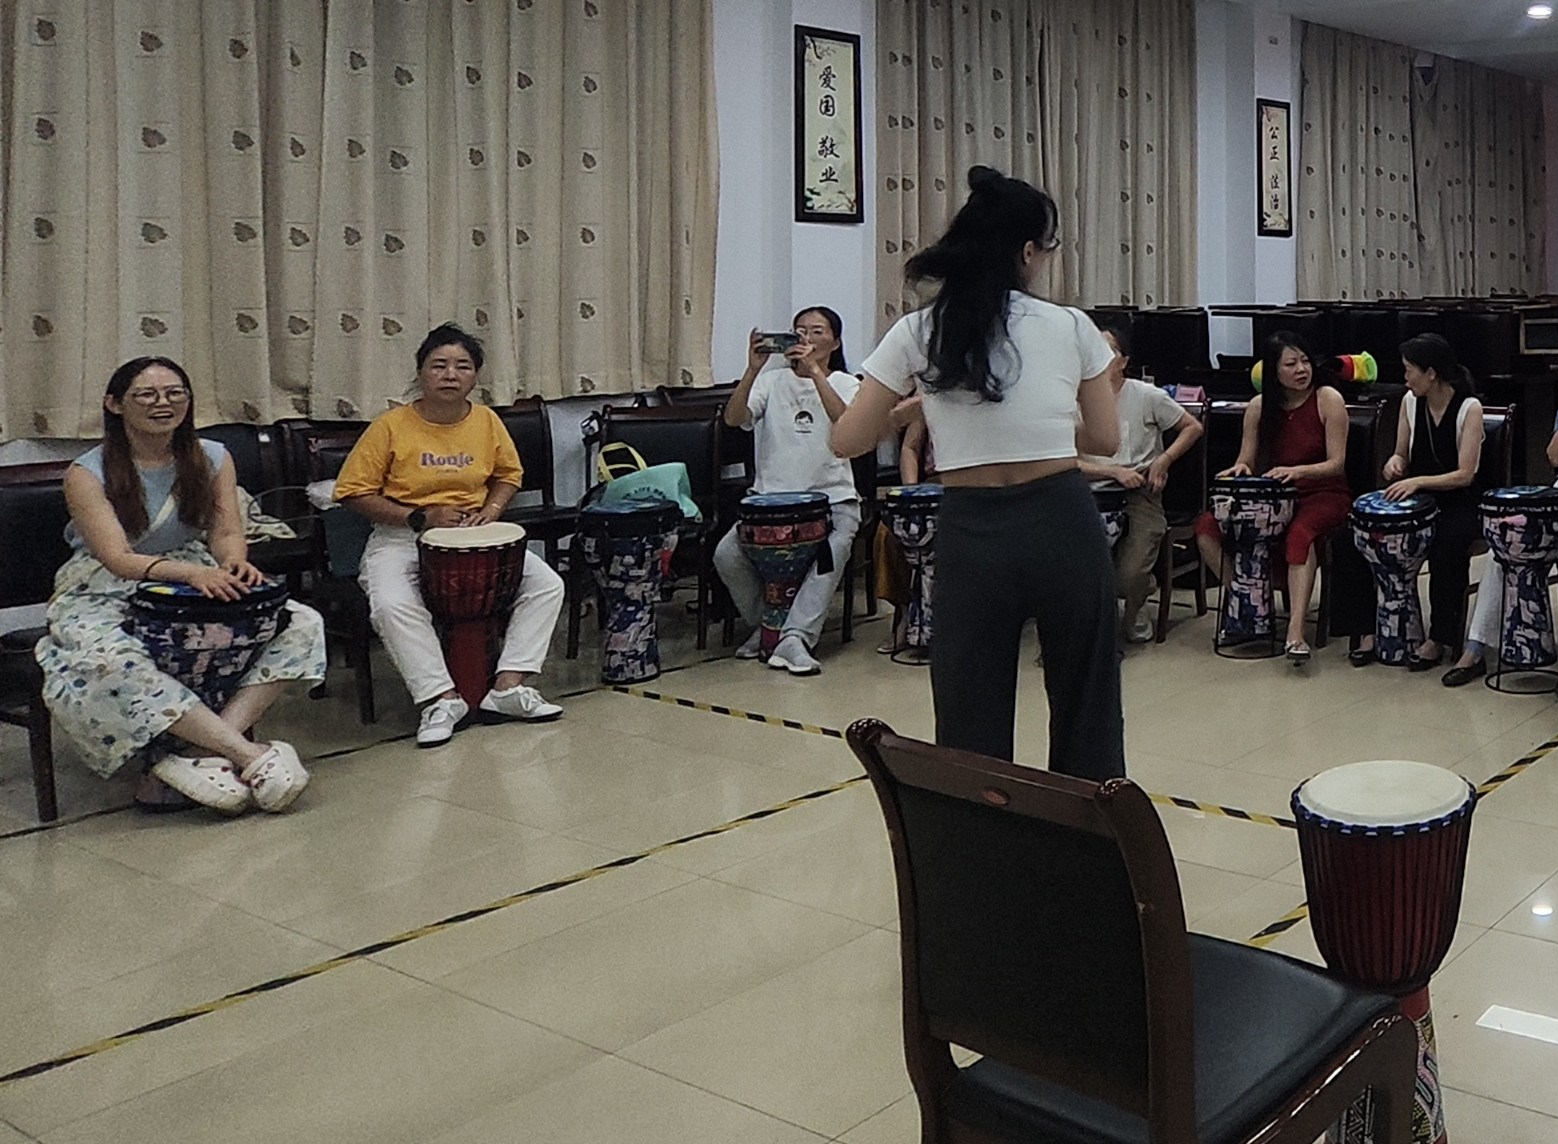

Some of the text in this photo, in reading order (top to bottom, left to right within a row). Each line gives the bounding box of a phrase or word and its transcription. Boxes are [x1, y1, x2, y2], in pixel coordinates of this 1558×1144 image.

[818, 65, 840, 184] 爱国 敬业
[1268, 126, 1280, 160] 公正
